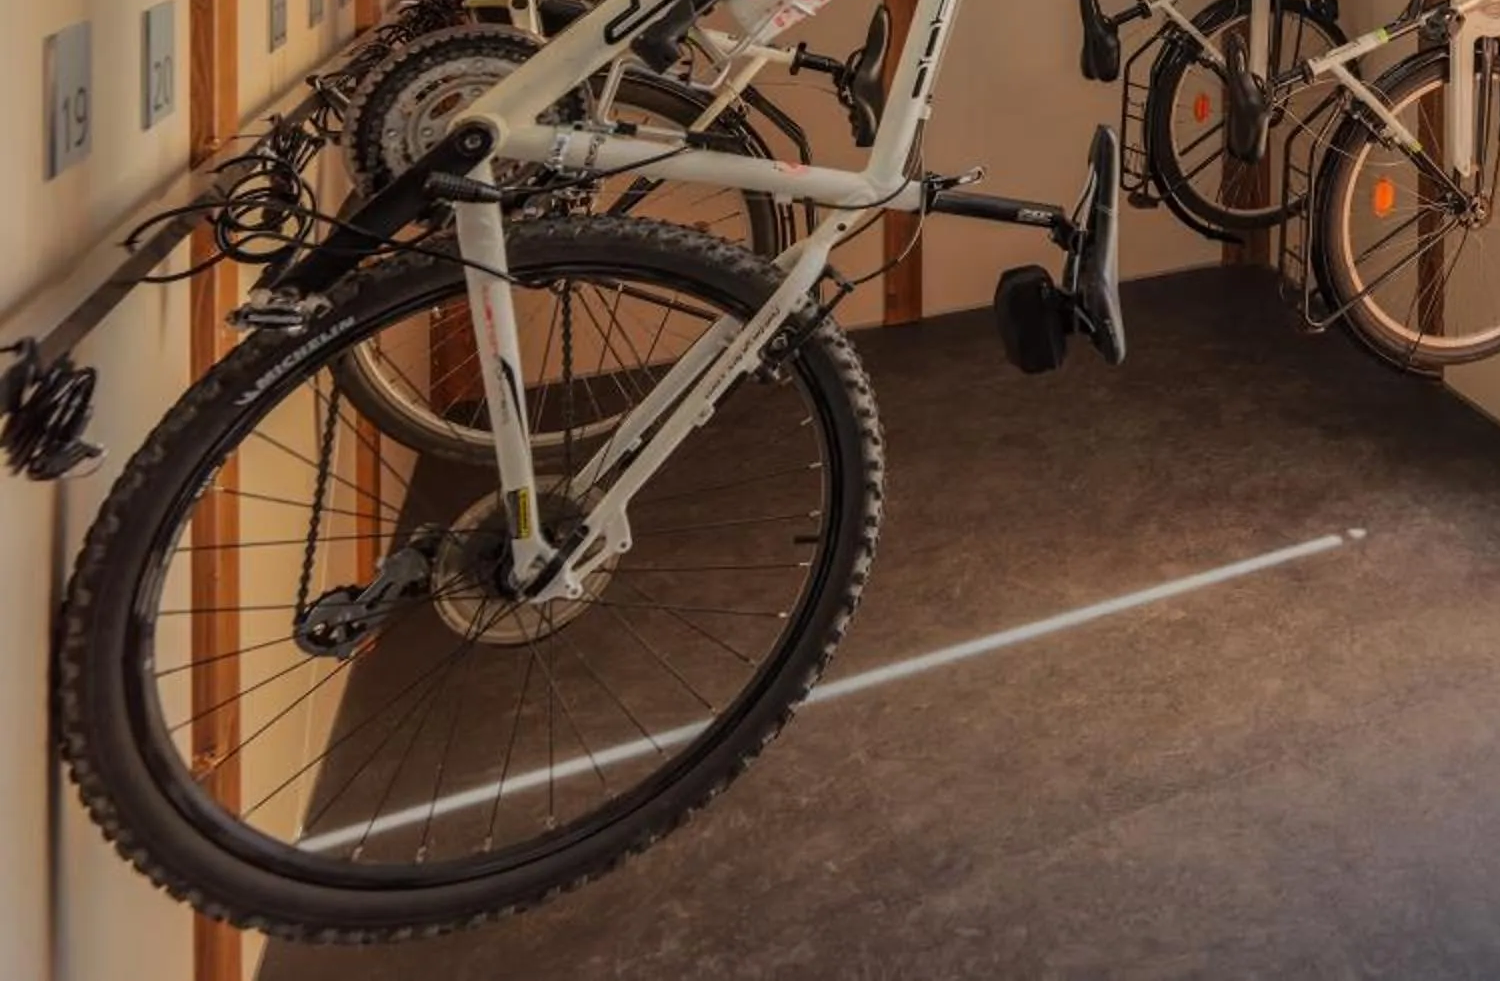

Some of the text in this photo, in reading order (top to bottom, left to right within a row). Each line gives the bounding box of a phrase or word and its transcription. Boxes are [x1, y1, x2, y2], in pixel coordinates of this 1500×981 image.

[153, 55, 174, 111] 20
[62, 85, 88, 153] 19
[255, 315, 356, 391] MICHELIN
